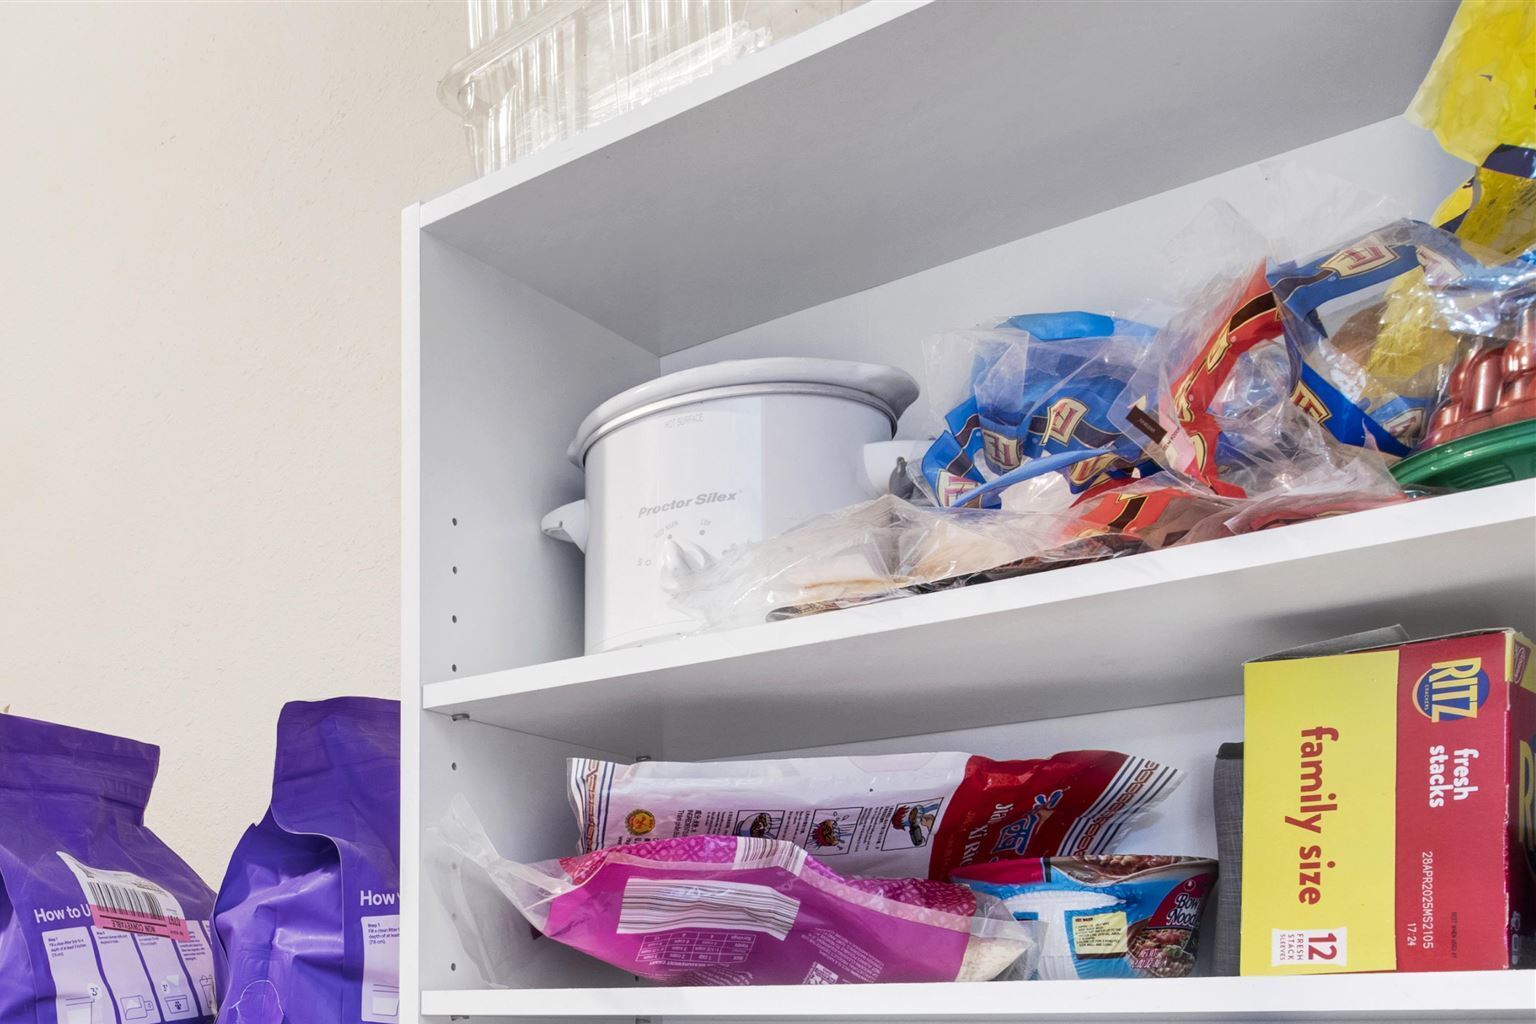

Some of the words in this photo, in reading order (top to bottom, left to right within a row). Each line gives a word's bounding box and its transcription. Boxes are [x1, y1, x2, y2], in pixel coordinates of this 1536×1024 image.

[638, 497, 693, 518] Proctor
[695, 491, 738, 505] Silex
[1428, 656, 1482, 723] RITZ
[1284, 726, 1339, 834] family
[1429, 744, 1454, 808] stacks
[1453, 748, 1479, 801] fresh
[1299, 845, 1336, 905] size
[360, 890, 396, 906] How
[34, 907, 64, 924] How
[66, 905, 80, 918] to
[1287, 934, 1295, 961] STACK
[1308, 932, 1337, 961] 12
[1407, 922, 1417, 946] 17:24
